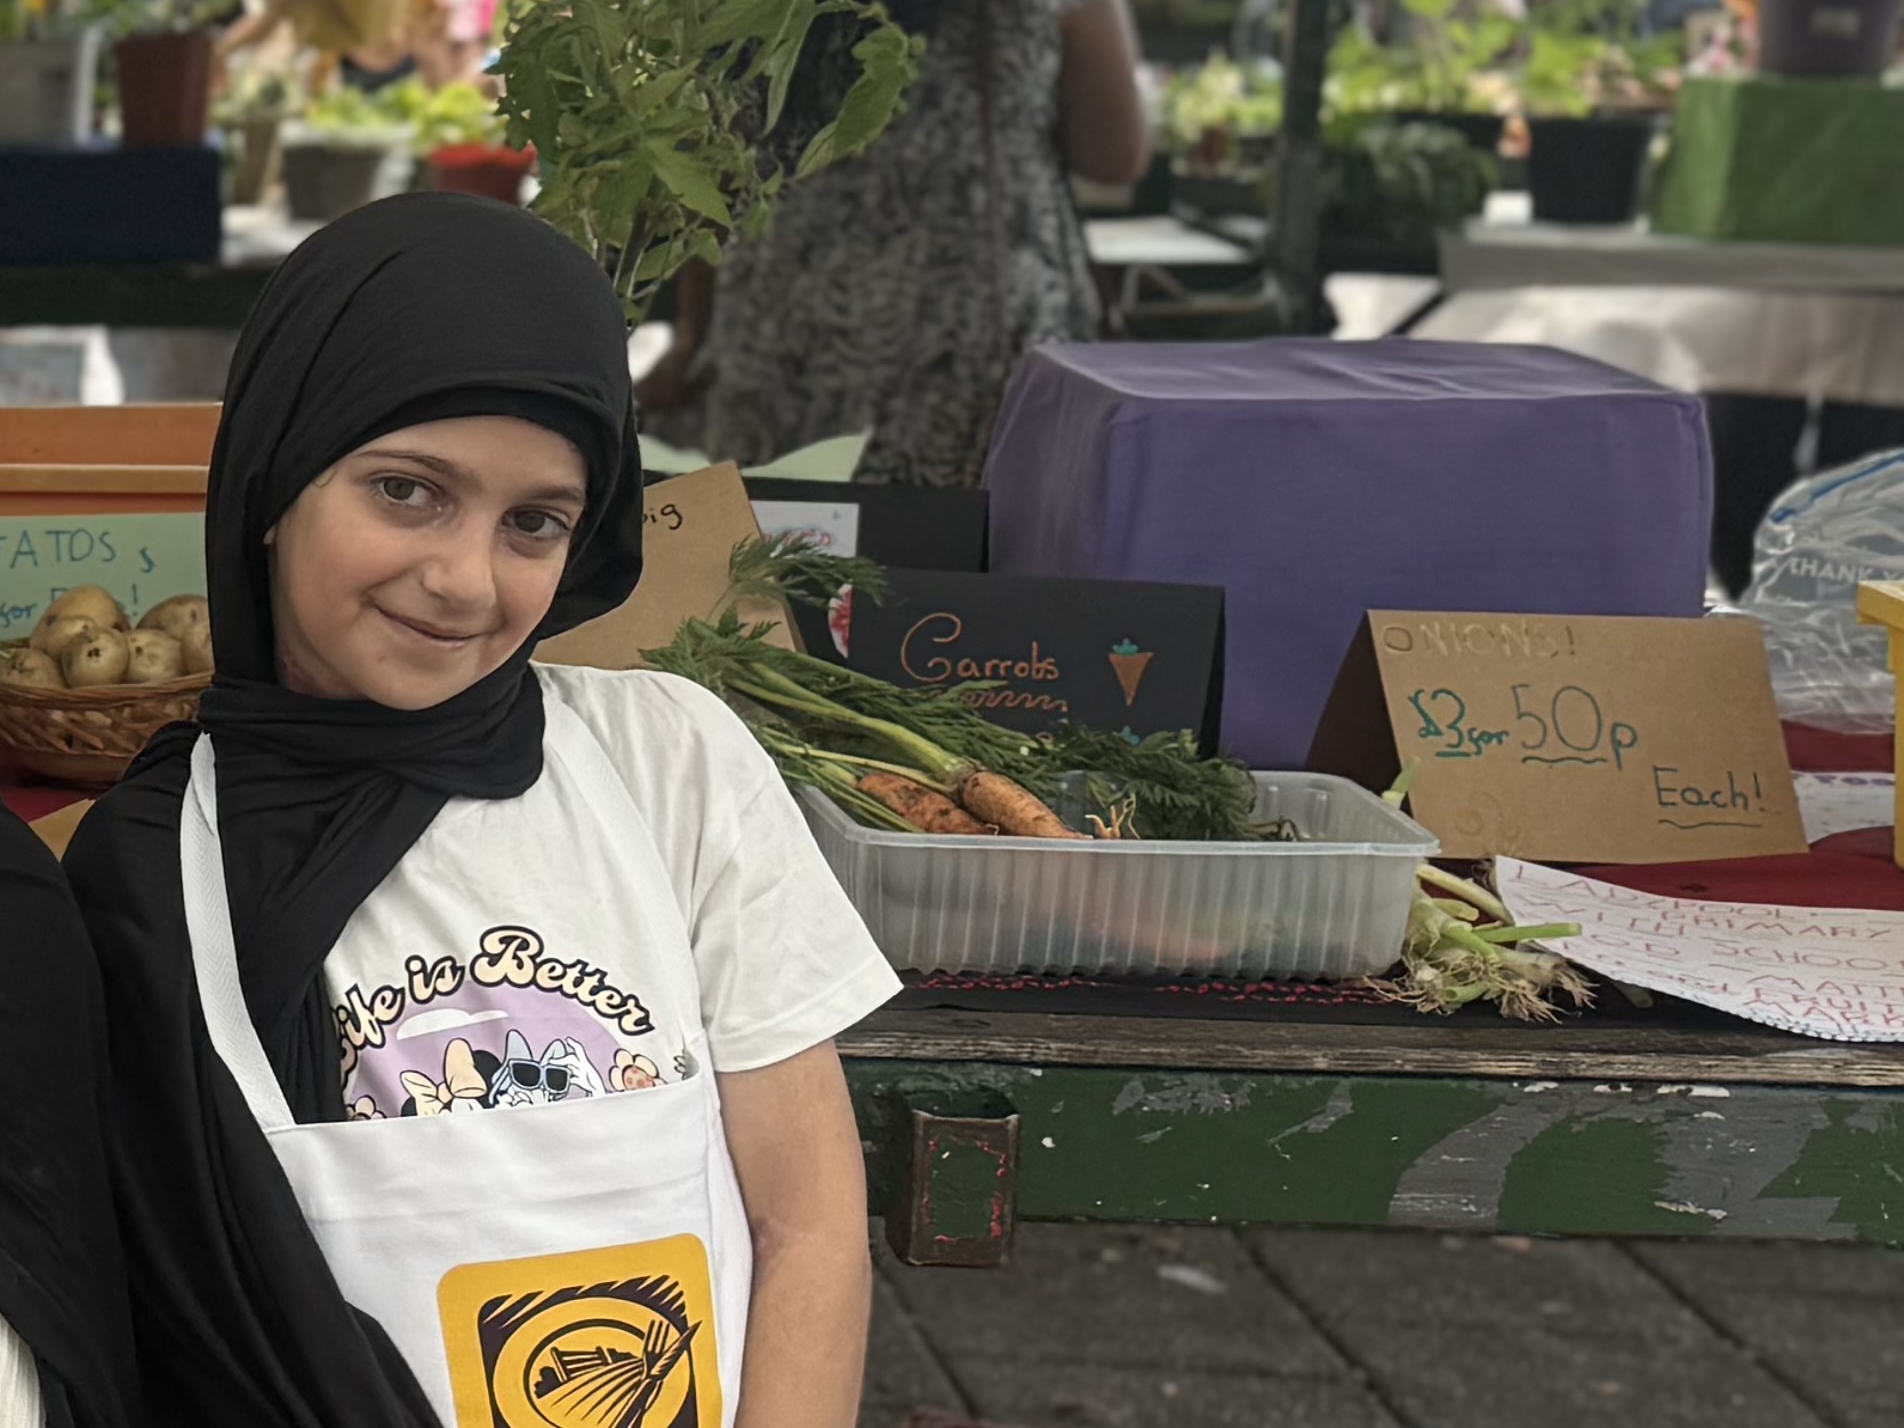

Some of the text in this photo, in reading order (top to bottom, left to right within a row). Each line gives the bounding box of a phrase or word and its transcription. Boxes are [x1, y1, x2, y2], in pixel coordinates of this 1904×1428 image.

[900, 612, 1061, 683] Carrots
[404, 954, 466, 1005] is
[469, 924, 656, 1037] Better
[1712, 942, 1904, 970] SCHOO
